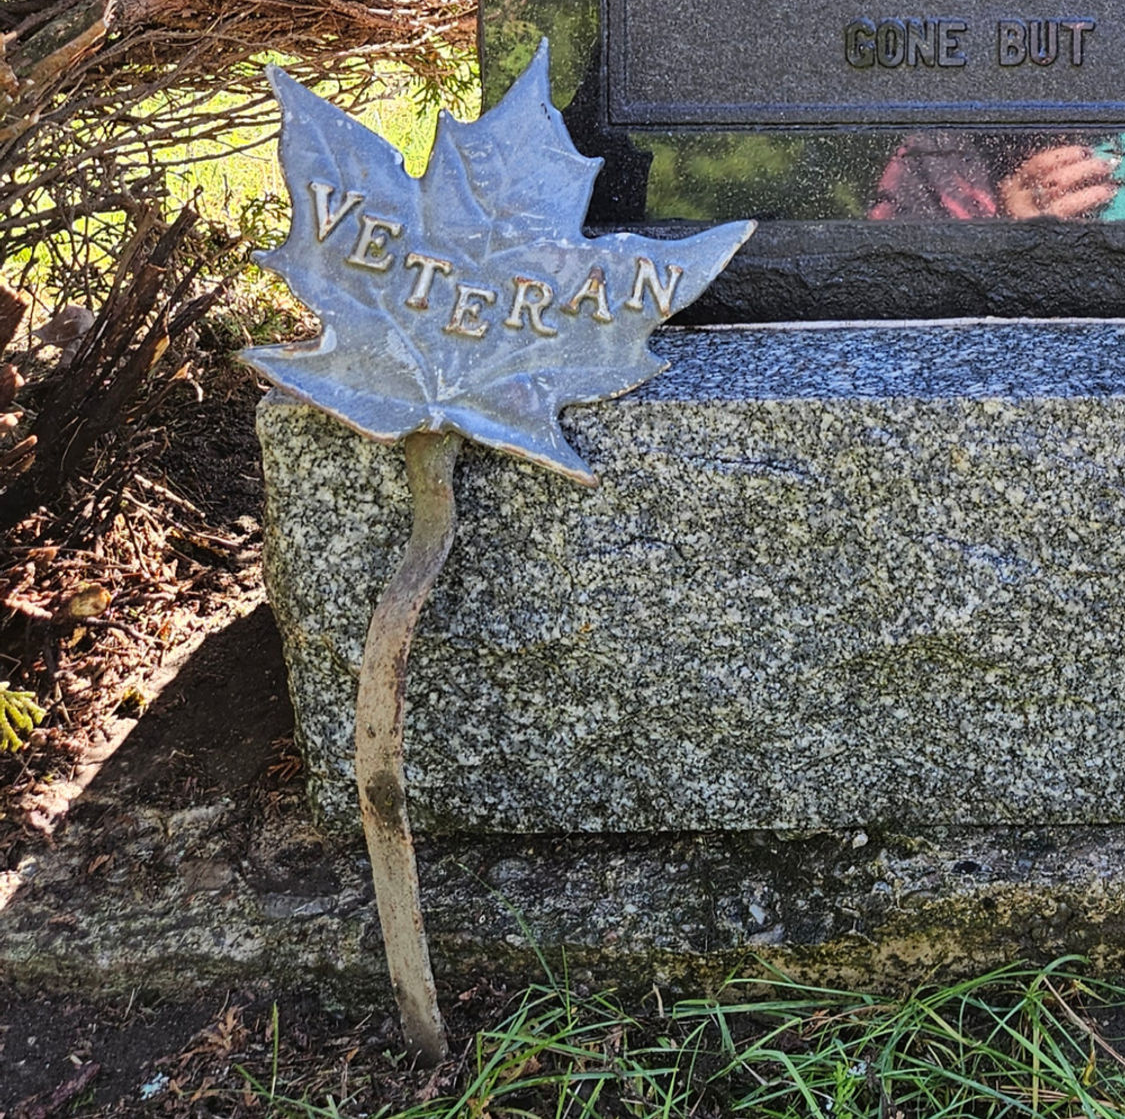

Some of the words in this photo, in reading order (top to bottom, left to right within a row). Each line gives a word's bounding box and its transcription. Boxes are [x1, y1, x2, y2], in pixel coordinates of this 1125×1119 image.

[845, 18, 968, 69] GONE
[999, 18, 1095, 68] BUT
[309, 181, 685, 340] VETERAN
